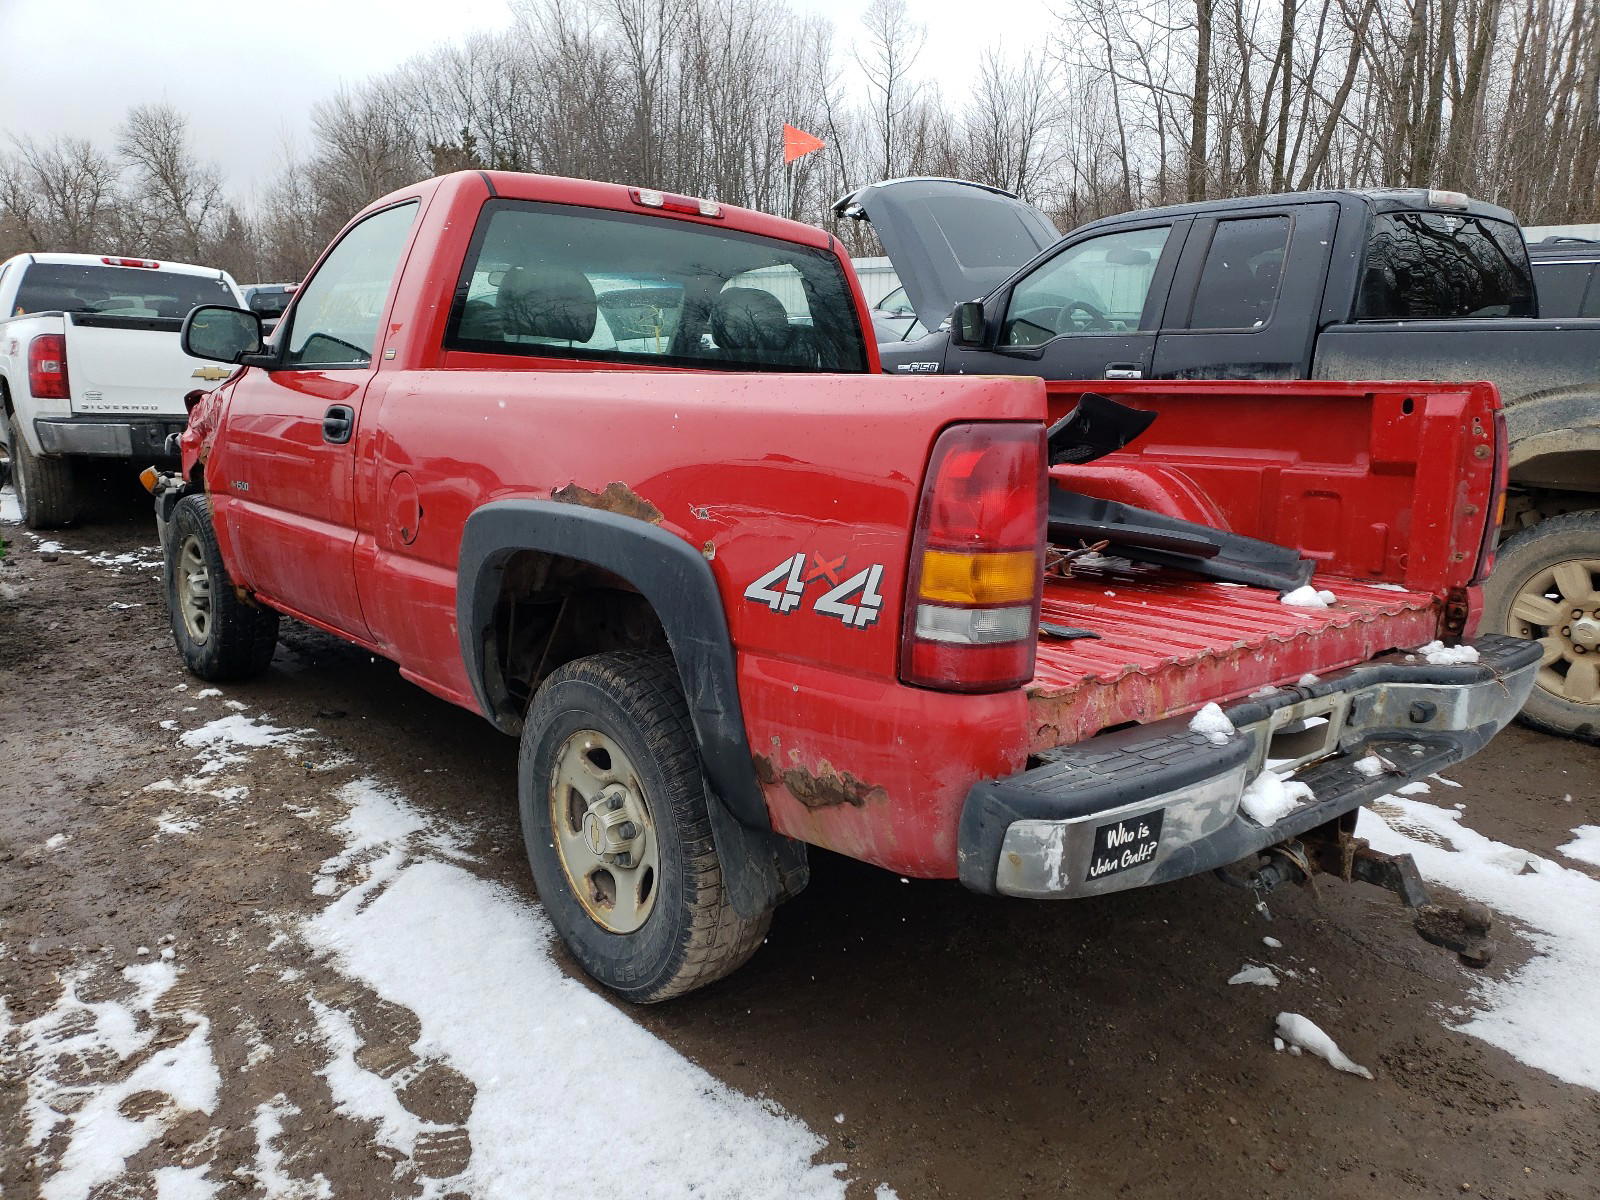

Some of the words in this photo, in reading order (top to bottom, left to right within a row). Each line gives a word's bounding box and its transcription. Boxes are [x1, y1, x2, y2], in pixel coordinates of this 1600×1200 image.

[1107, 822, 1135, 849] Who
[1137, 822, 1150, 839] is
[1090, 858, 1118, 877] John
[1121, 841, 1158, 868] Galt?
